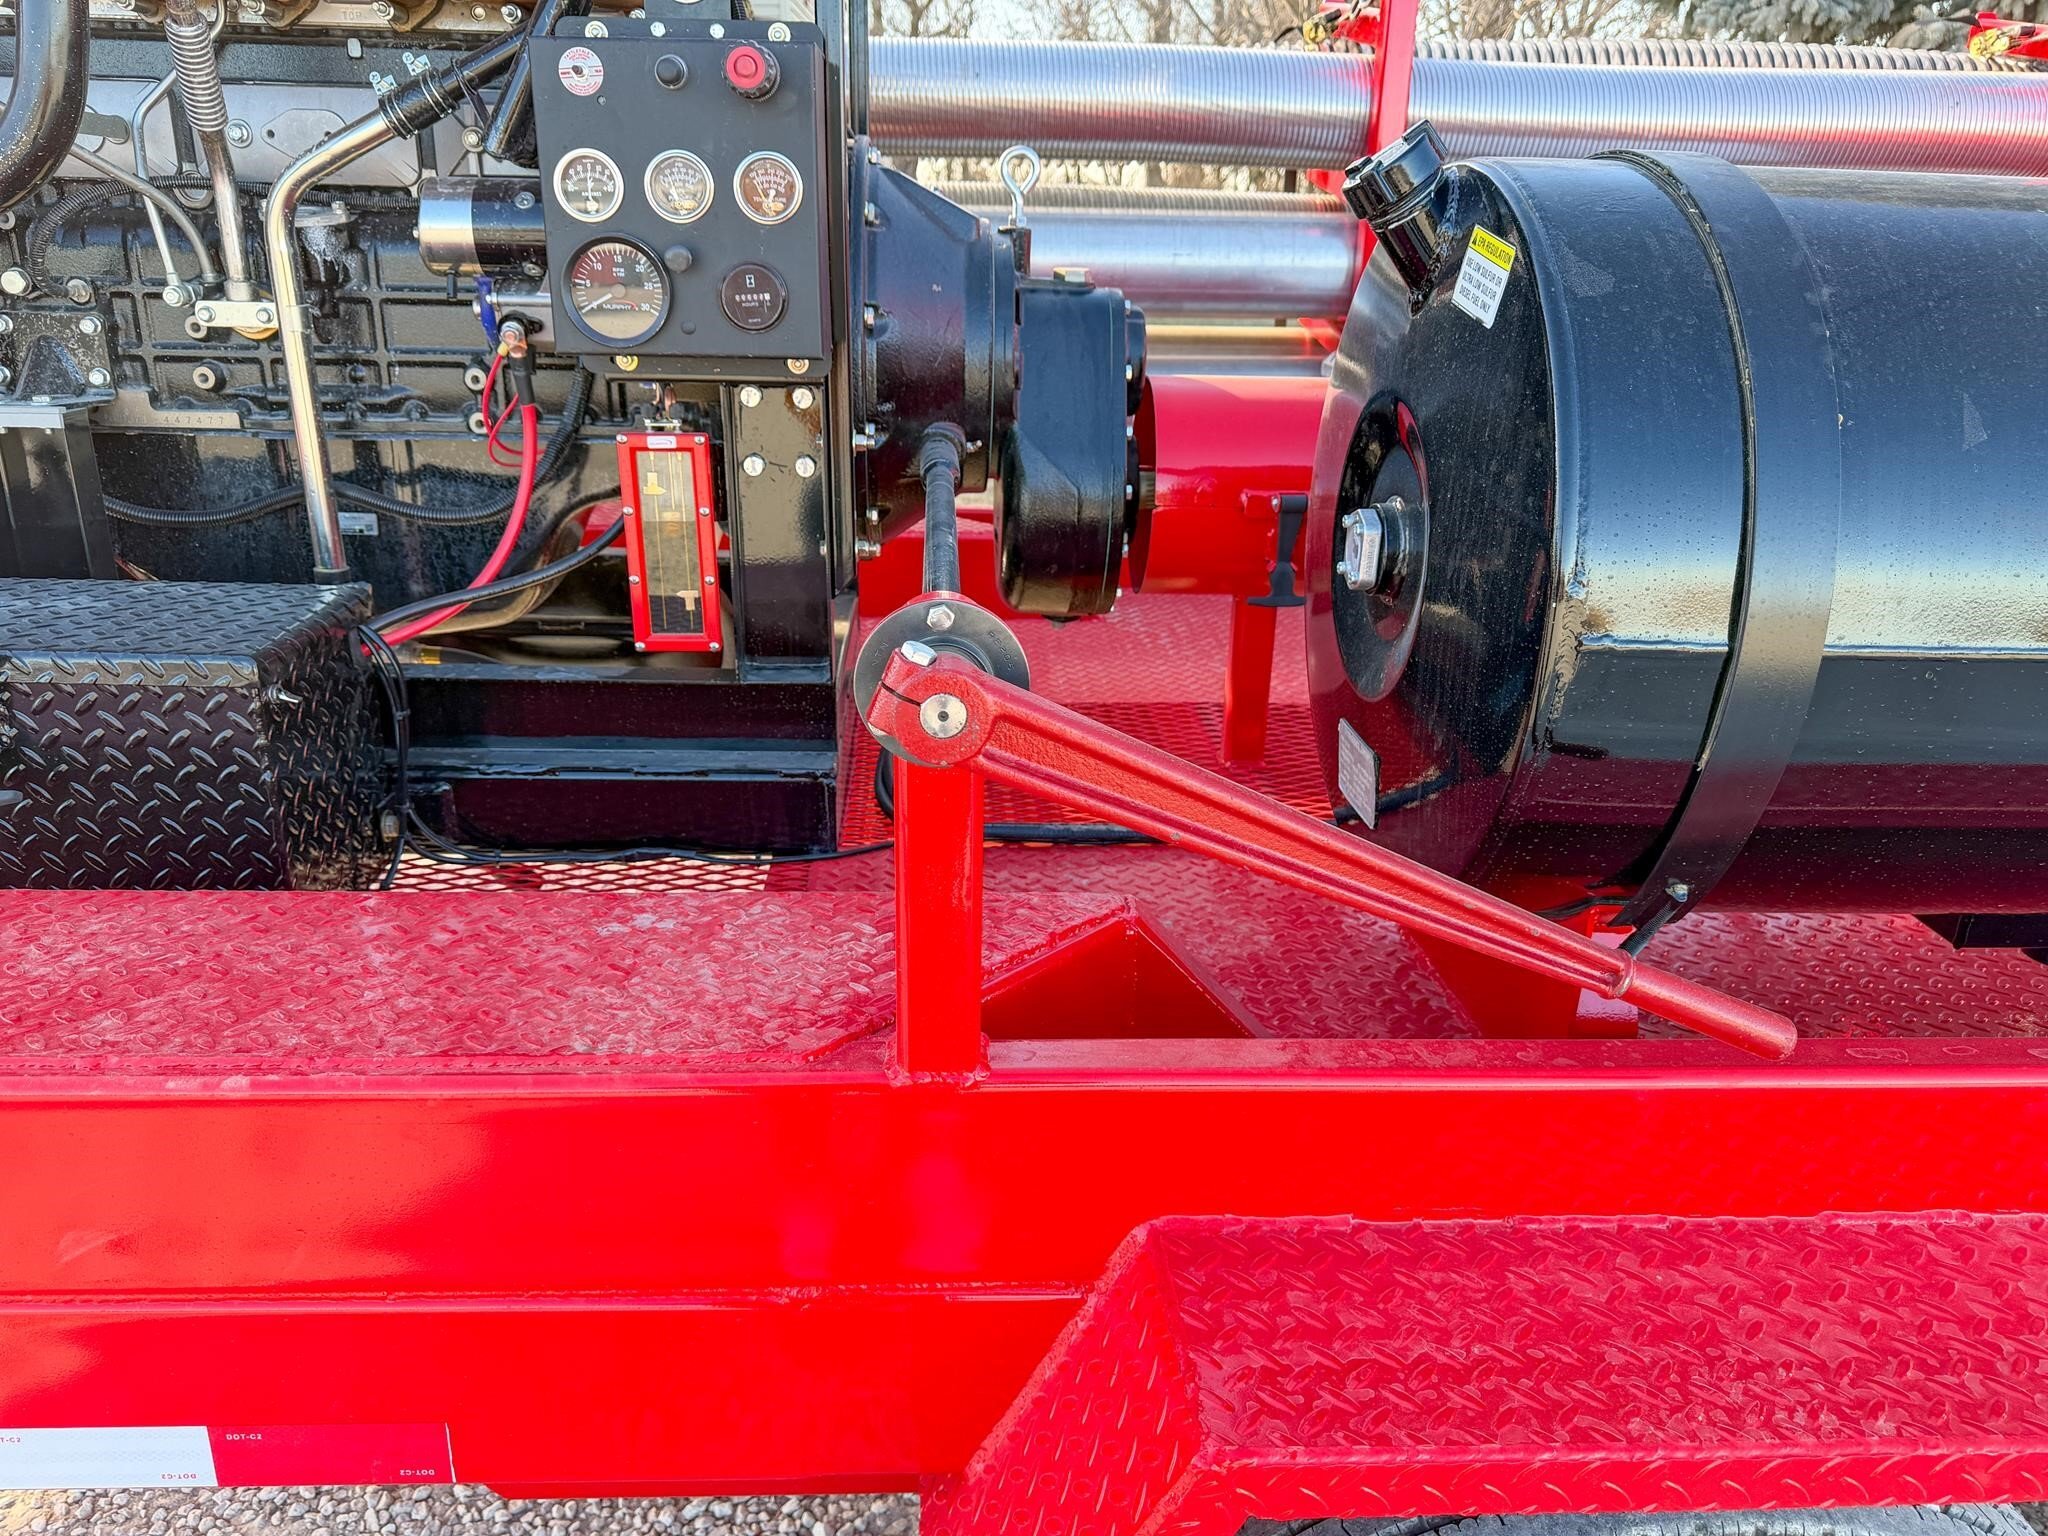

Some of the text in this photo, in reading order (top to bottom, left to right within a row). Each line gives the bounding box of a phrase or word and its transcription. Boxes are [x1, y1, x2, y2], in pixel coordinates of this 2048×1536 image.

[1477, 236, 1513, 266] EPA REGULATION
[613, 254, 622, 263] 15
[593, 262, 645, 273] 10 20
[585, 279, 591, 287] 5
[643, 281, 653, 290] 25
[641, 303, 651, 312] 30
[1479, 299, 1491, 313] ONLY
[226, 1433, 262, 1441] DOT-C2
